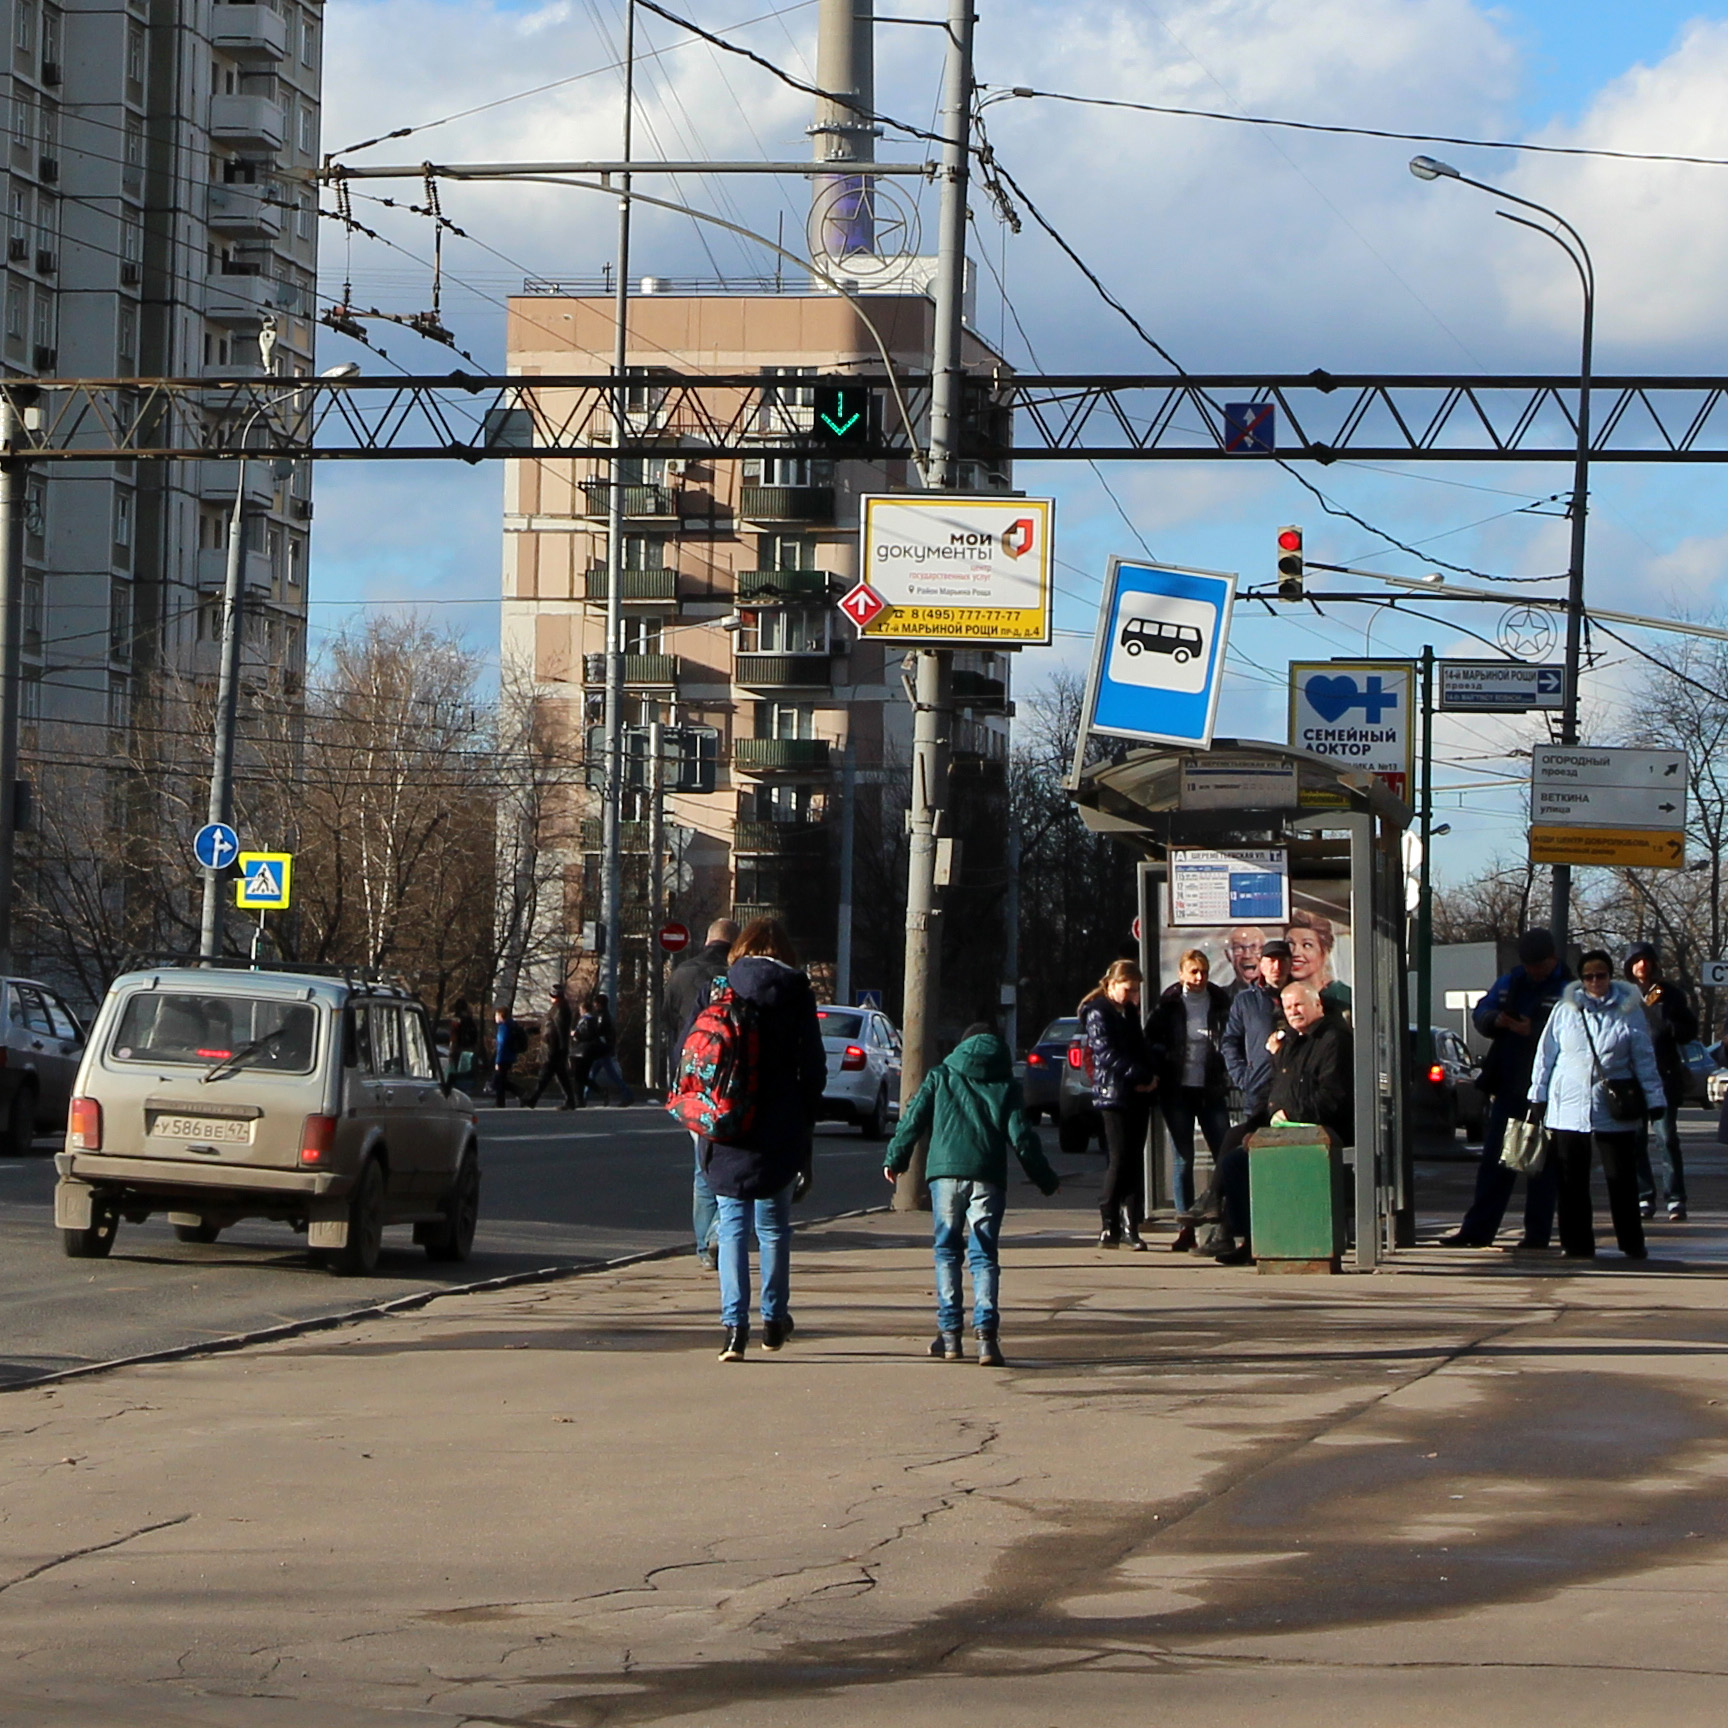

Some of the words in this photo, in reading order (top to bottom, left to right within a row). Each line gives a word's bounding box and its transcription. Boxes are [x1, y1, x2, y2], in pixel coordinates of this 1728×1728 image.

[950, 533, 992, 546] мои
[877, 545, 992, 563] документы
[972, 573, 992, 582] услуг
[917, 587, 939, 595] Район
[940, 588, 971, 597] Марьина
[972, 589, 992, 597] Роща
[911, 609, 919, 619] 8
[922, 609, 955, 621] (495)
[959, 610, 1021, 621] 777-77-77
[901, 622, 962, 635] МАРЬИНОЙ
[965, 625, 999, 636] РОЩИ
[1462, 669, 1510, 681] МАРЬИНОЙ
[1511, 671, 1537, 683] РОЩИ
[1445, 682, 1483, 690] проезд
[1303, 727, 1396, 742] СЕМЕЙНЫЙ
[1305, 743, 1371, 756] ДОКТОР
[1542, 755, 1610, 766] ОГОРОДНЫЙ
[1541, 767, 1578, 777] проезд
[1540, 793, 1590, 803] ВЕТКИНА
[1540, 805, 1571, 814] улица
